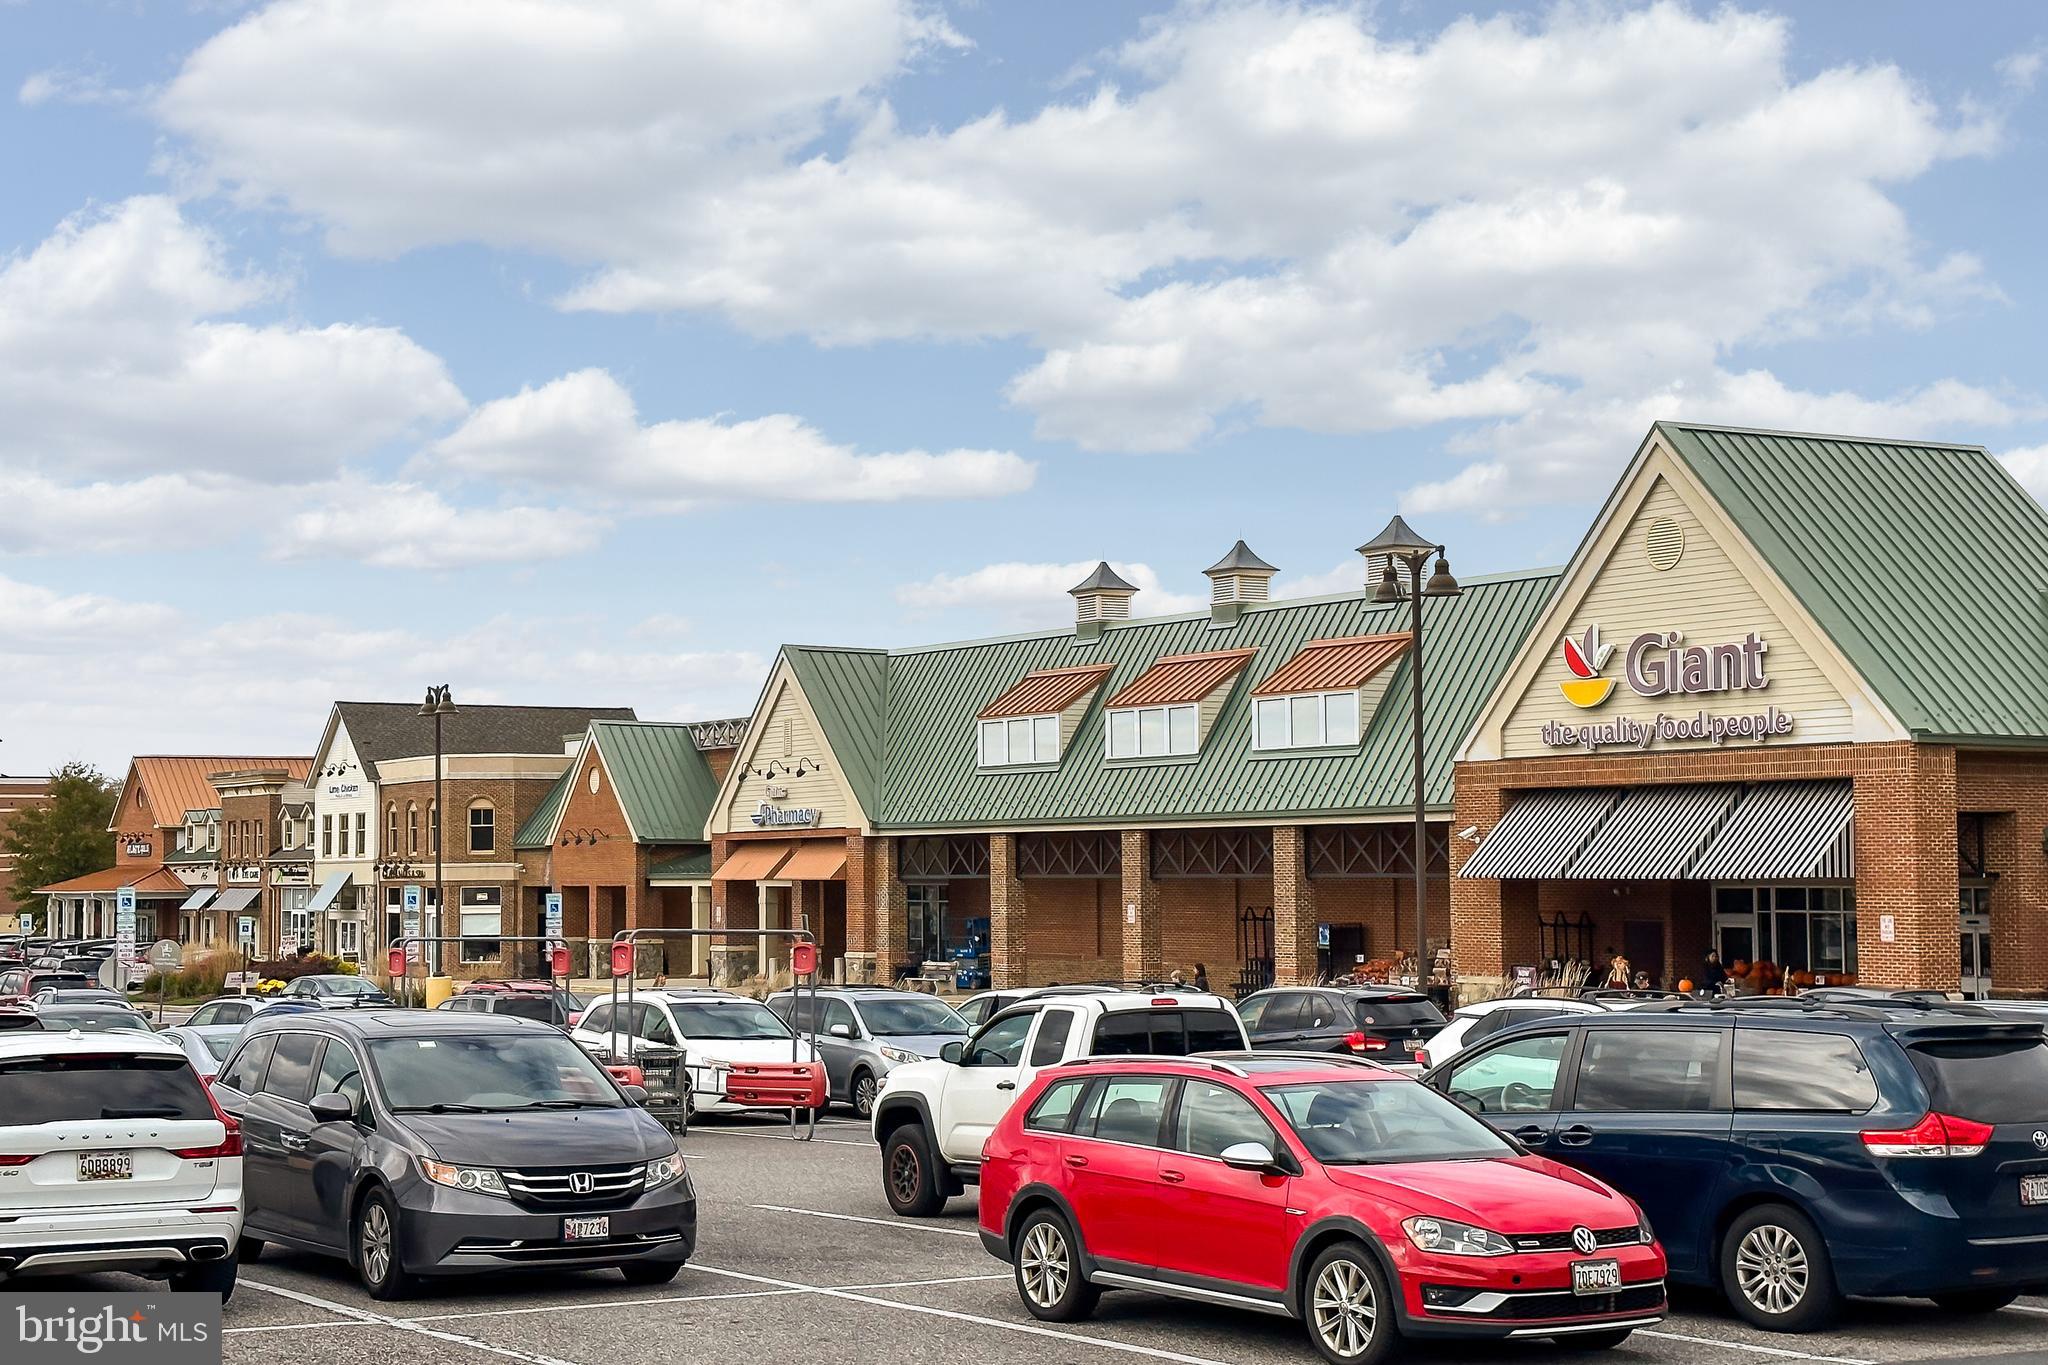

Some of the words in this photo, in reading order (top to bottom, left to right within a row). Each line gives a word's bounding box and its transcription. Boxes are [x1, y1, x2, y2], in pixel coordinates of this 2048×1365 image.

[1624, 631, 1772, 697] Giant
[1541, 718, 1576, 746] the
[1577, 716, 1651, 750] quality
[1655, 709, 1709, 740] food
[1710, 706, 1793, 745] people
[764, 804, 822, 827] Pharmacy
[57, 1132, 158, 1141] VOLVO
